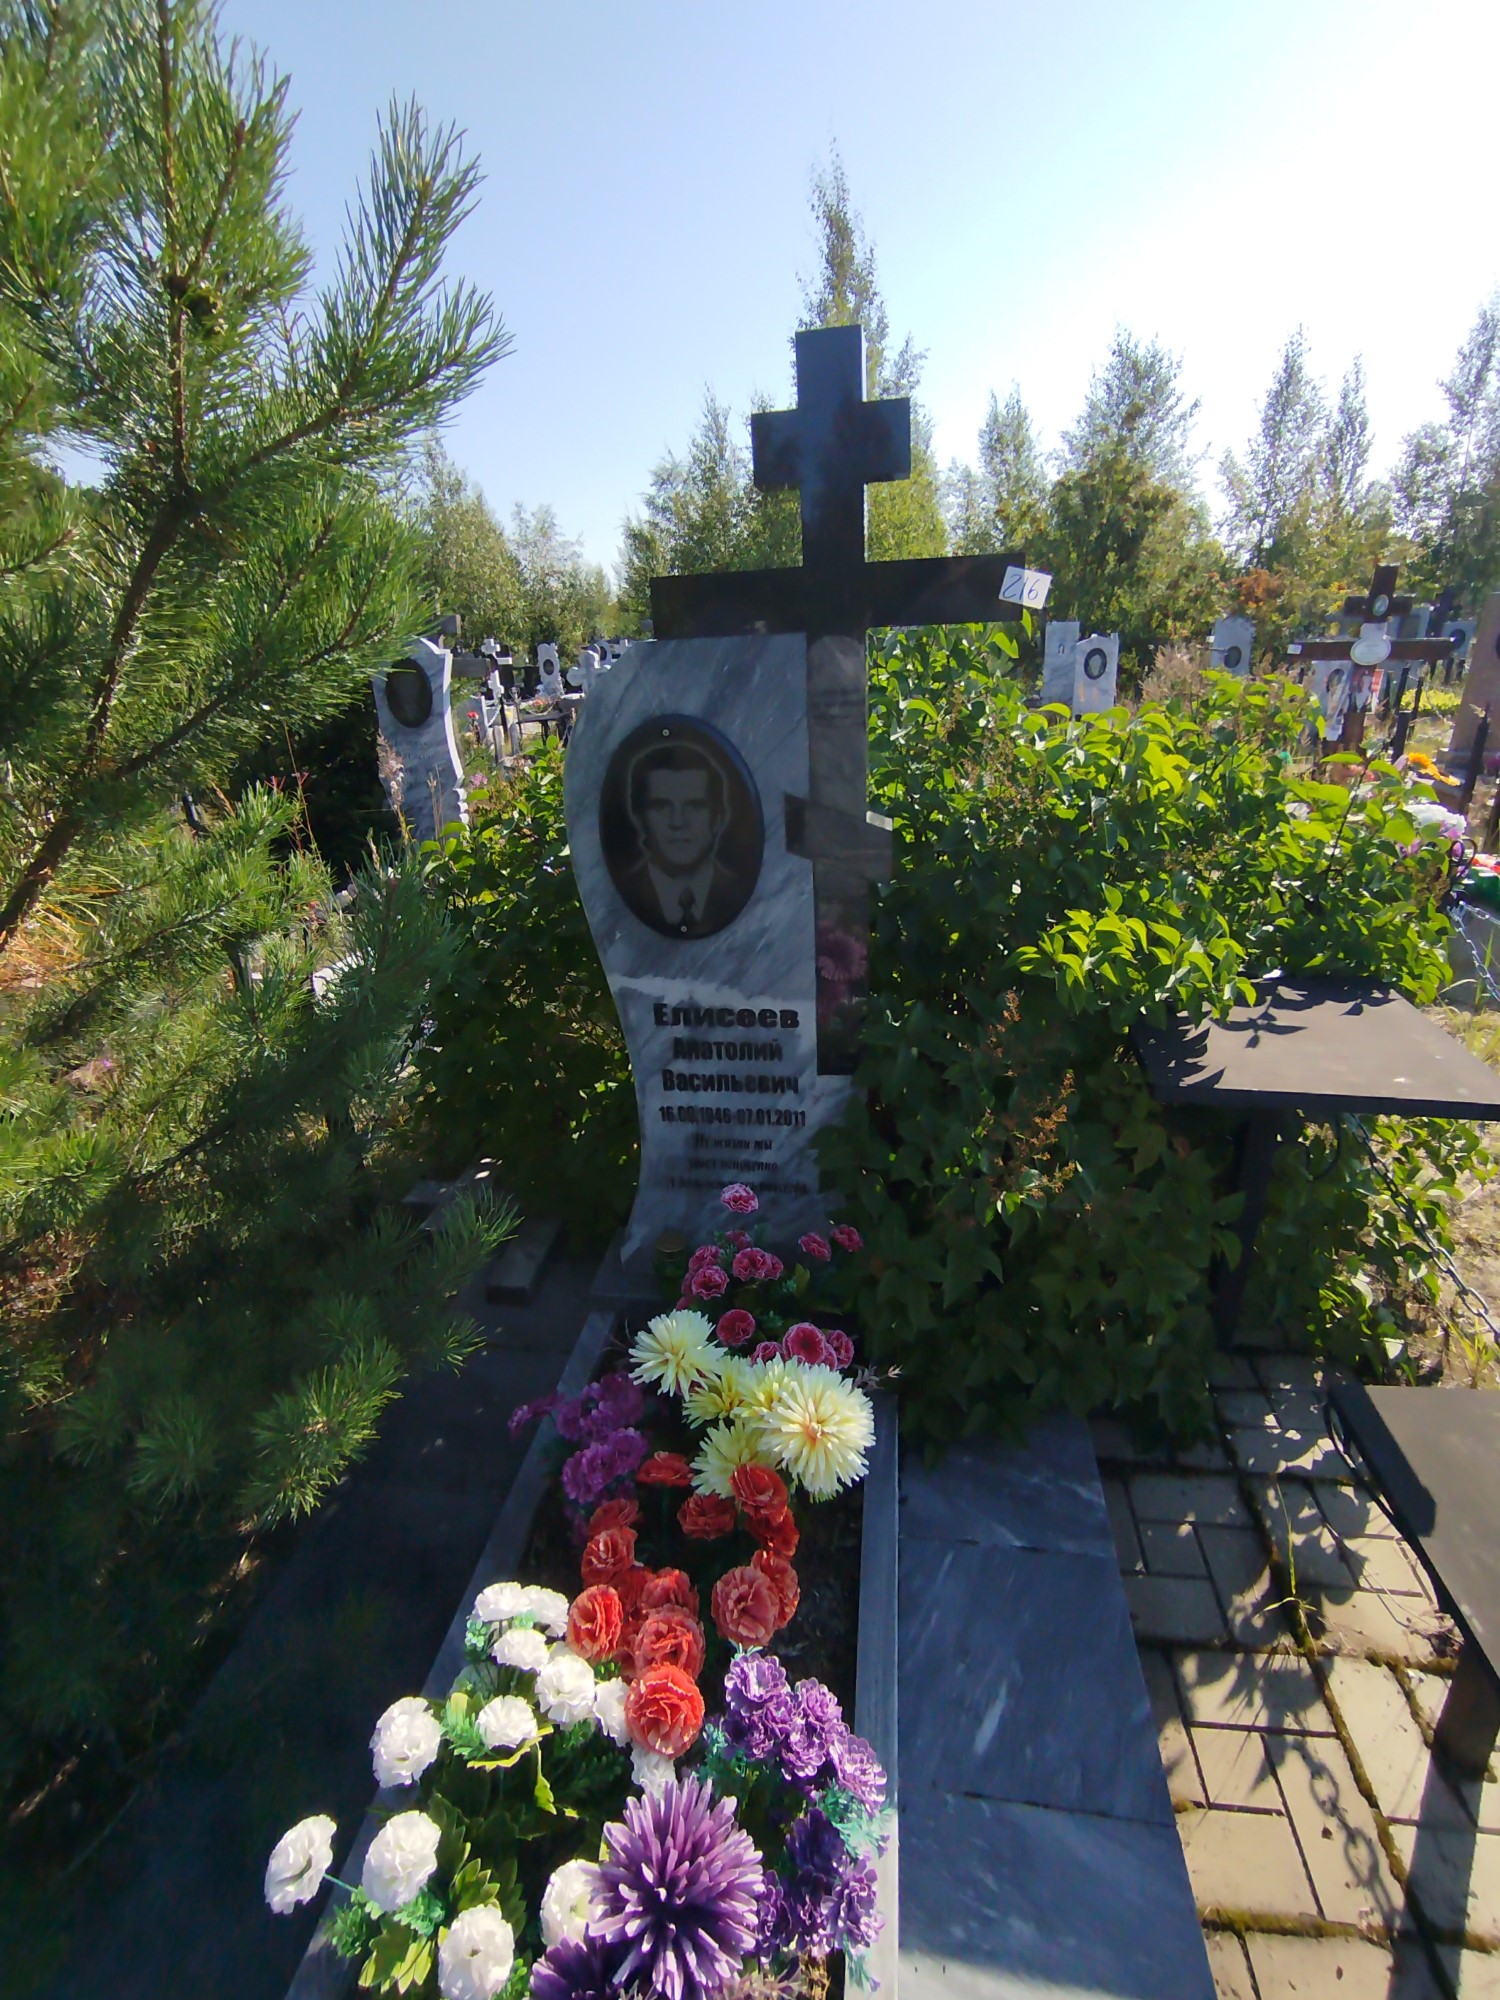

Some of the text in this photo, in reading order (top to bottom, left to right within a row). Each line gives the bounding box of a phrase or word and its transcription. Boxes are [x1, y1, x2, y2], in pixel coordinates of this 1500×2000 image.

[1002, 573, 1040, 601] 216
[672, 1036, 784, 1062] Анатолий
[661, 1069, 799, 1094] Васильевич
